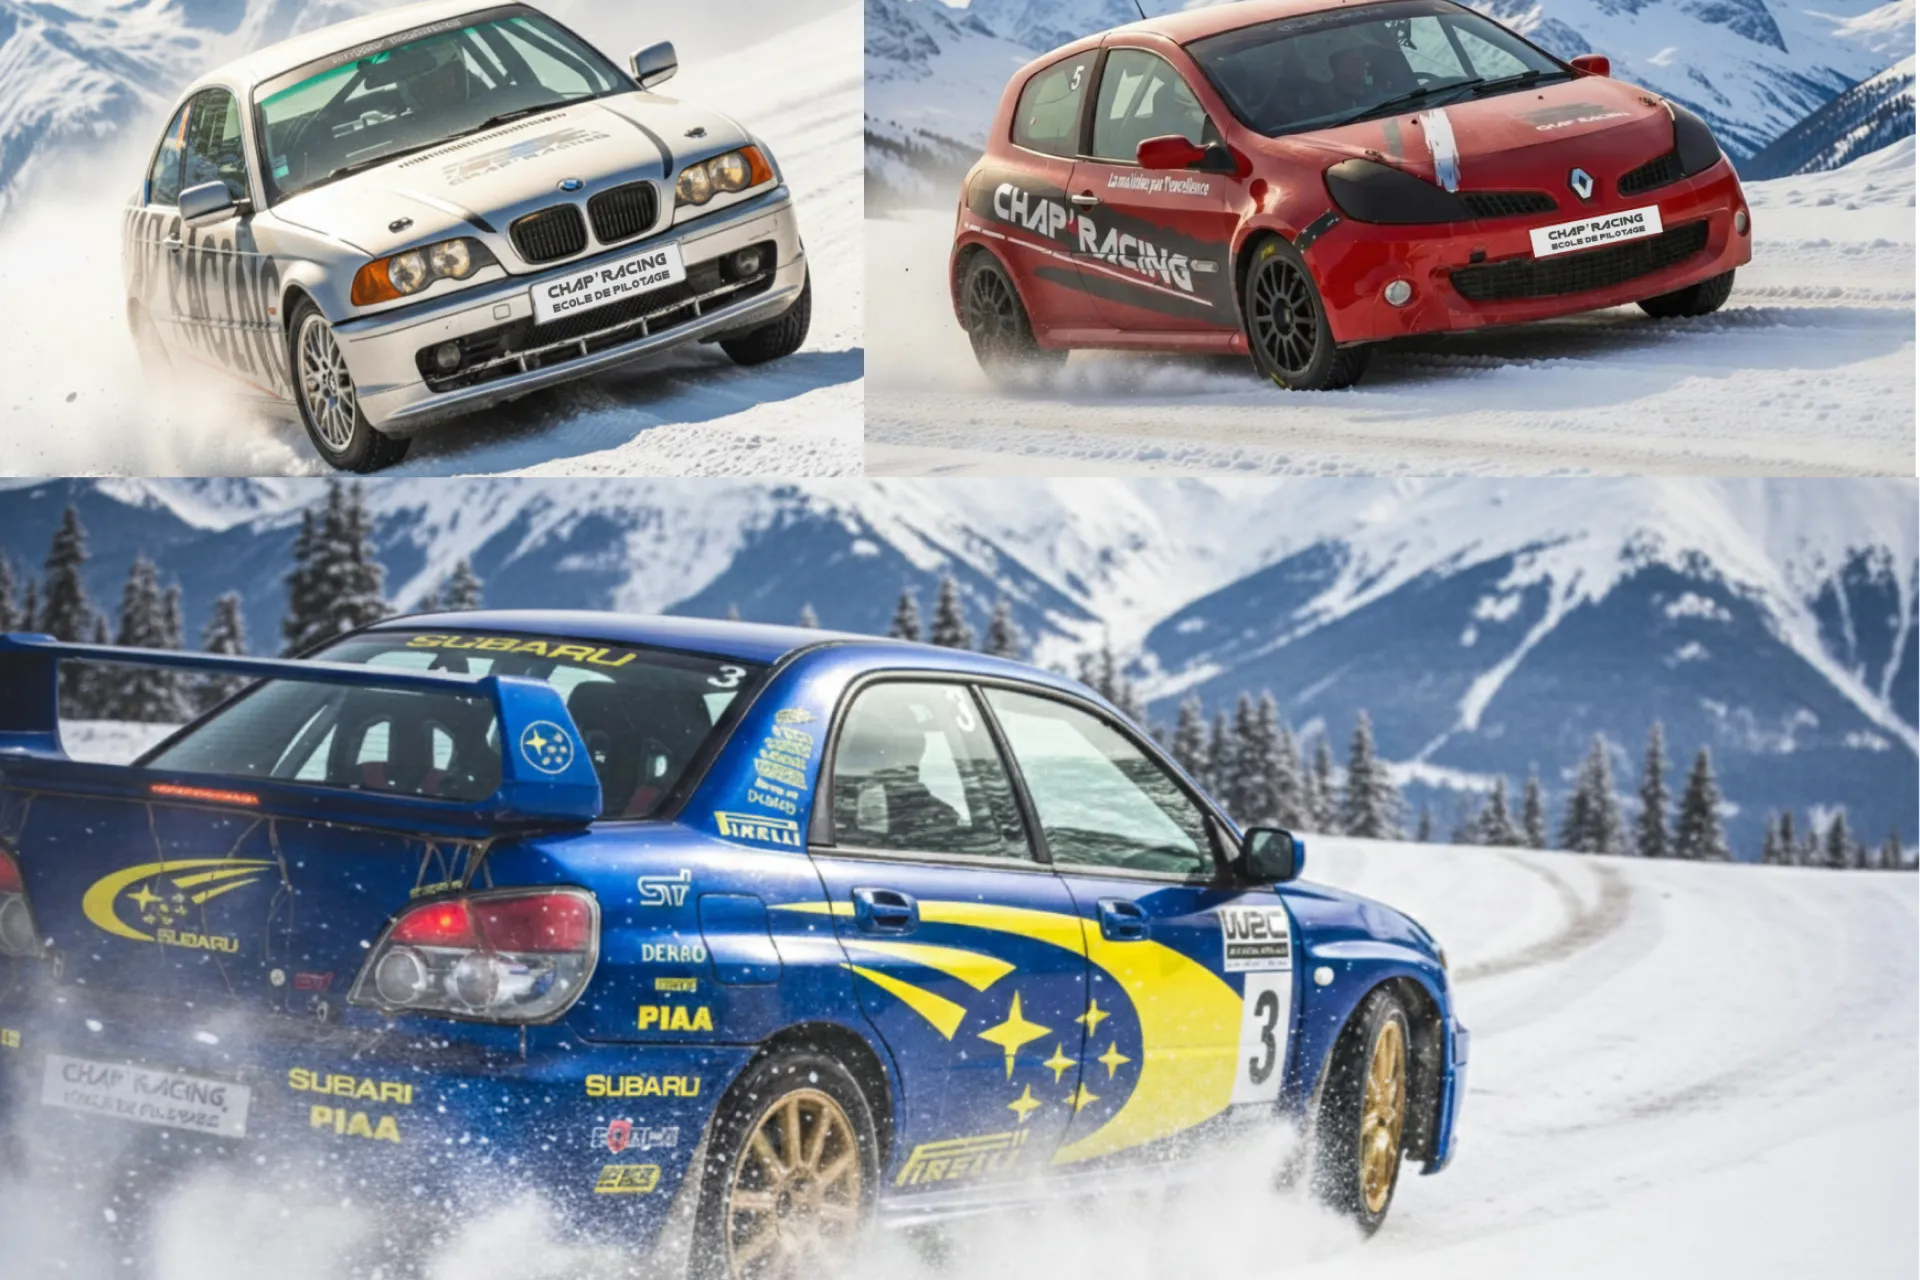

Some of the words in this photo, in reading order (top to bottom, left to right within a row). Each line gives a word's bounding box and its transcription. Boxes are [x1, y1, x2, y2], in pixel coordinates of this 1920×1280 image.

[1070, 65, 1085, 91] 5
[1551, 238, 1584, 251] ECOLE
[1585, 234, 1599, 244] DE
[1599, 225, 1646, 241] PILOTAGE
[552, 293, 594, 314] ECOLE
[595, 288, 611, 301] DE
[612, 269, 671, 296] PILOTAGE
[405, 634, 638, 668] SUBARU
[706, 664, 748, 689] 3
[156, 928, 240, 954] SUBARU
[637, 1004, 714, 1032] PIAA
[1248, 989, 1280, 1086] 3
[585, 1073, 701, 1097] SUBARU
[309, 1104, 401, 1144] PIAA
